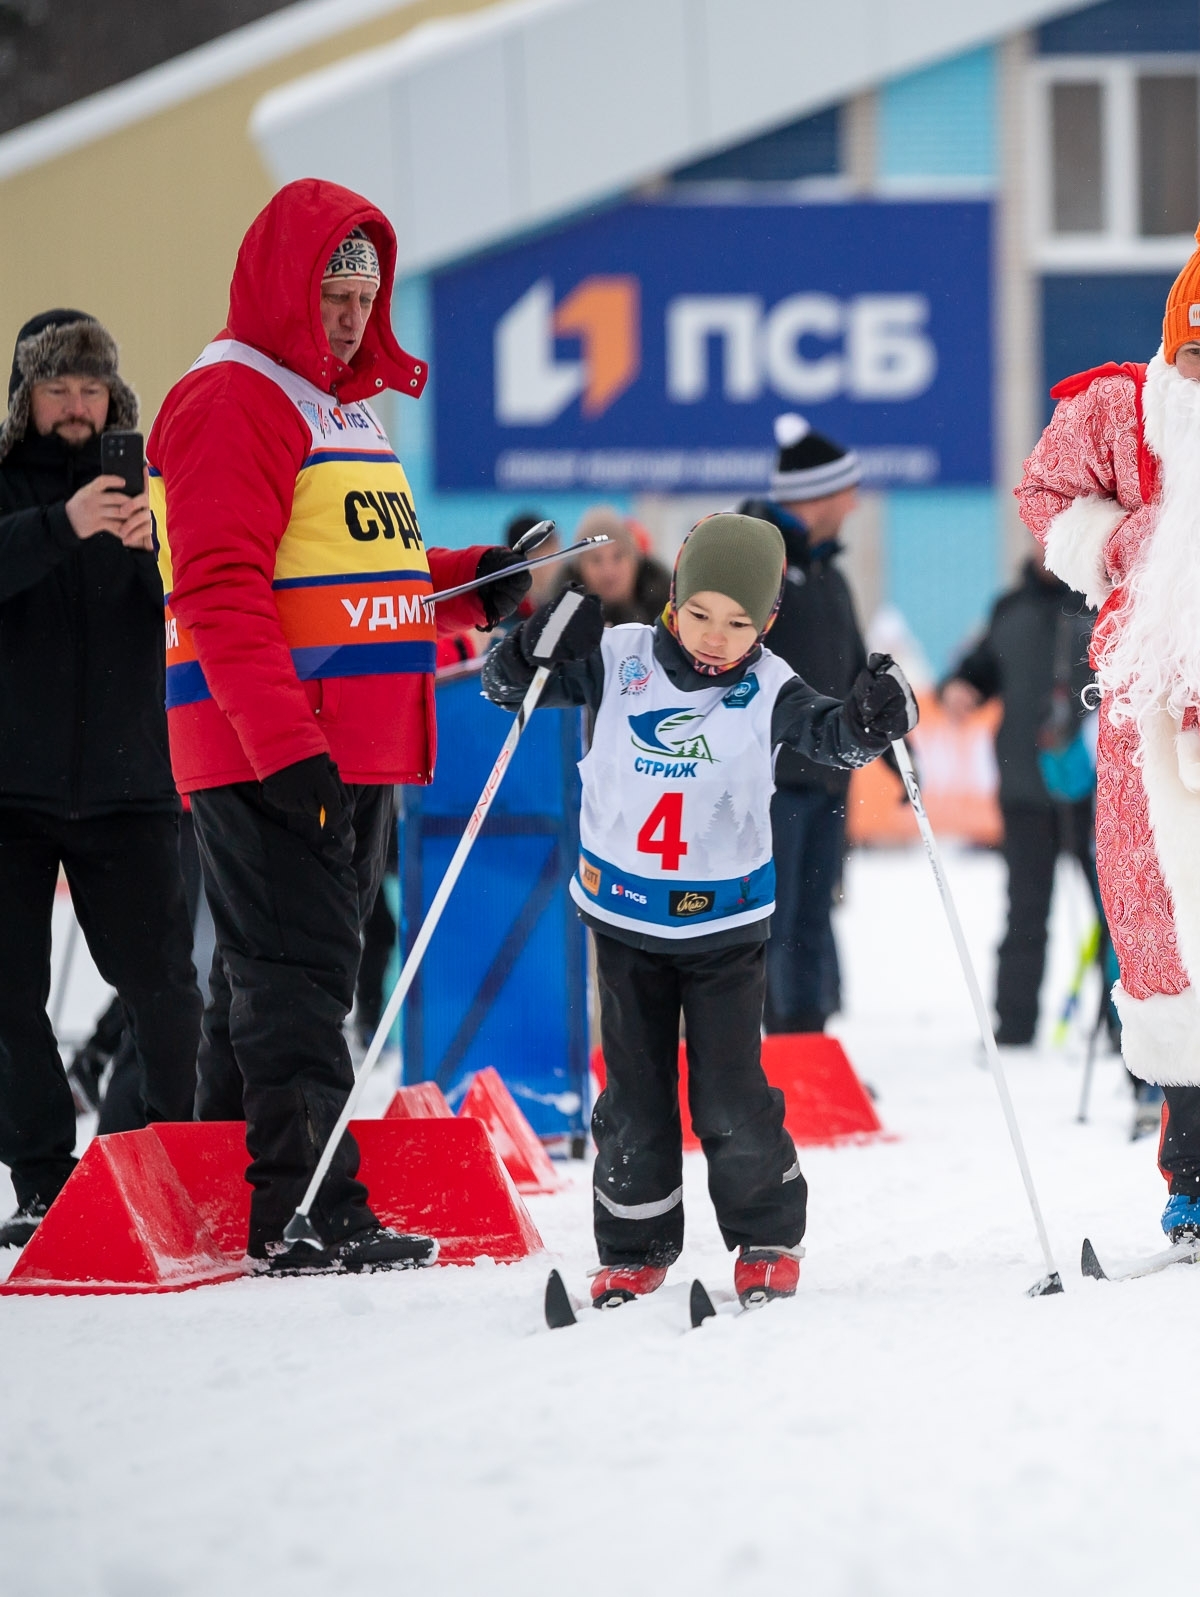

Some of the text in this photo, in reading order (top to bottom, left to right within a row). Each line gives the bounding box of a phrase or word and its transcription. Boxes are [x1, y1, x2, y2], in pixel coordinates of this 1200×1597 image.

[667, 292, 937, 402] ПСБ
[345, 412, 369, 429] ПСБ
[634, 756, 697, 778] СТРИЖ
[467, 750, 509, 839] SPINE
[637, 792, 688, 871] 4
[624, 889, 647, 904] ПСБ
